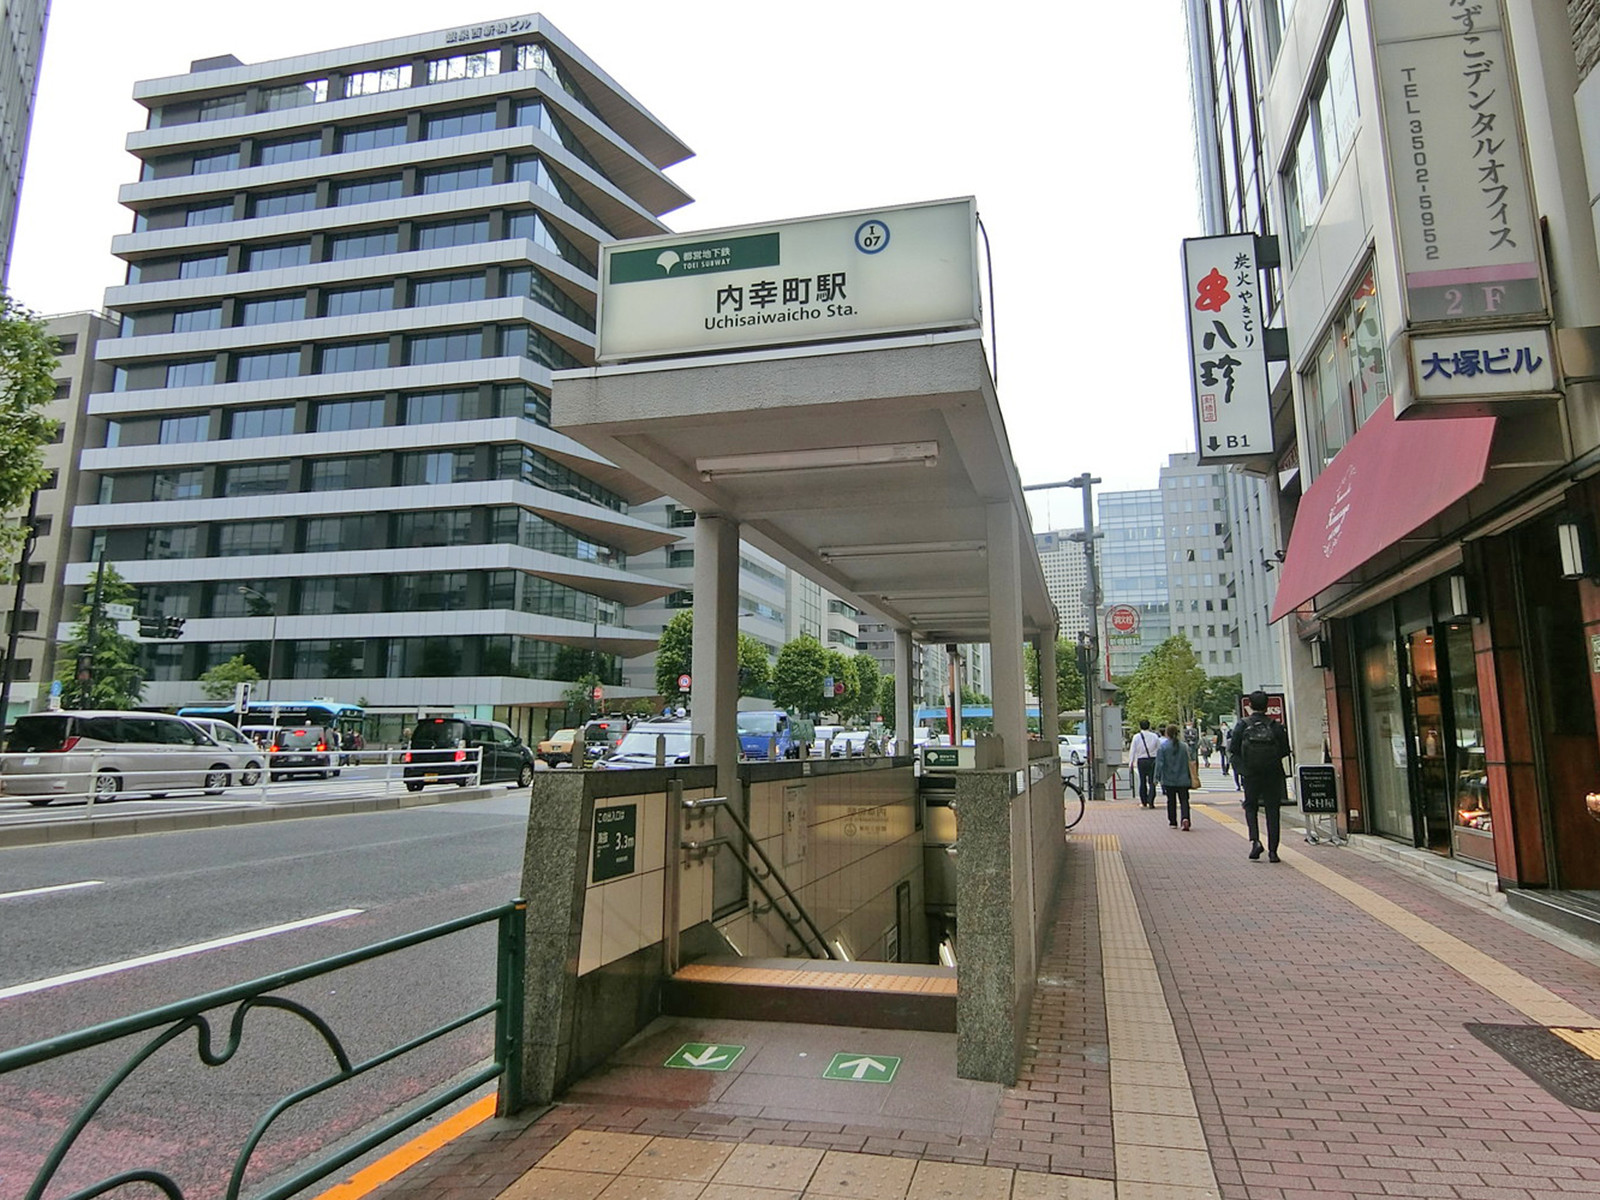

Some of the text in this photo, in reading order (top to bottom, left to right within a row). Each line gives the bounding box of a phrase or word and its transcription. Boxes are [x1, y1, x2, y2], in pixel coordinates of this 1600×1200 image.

[1401, 67, 1440, 260] TEL 3502-5952
[864, 235, 881, 247] 07
[683, 246, 731, 261] 都営地下鉄
[683, 258, 731, 270] TOEI SUBWAY
[716, 272, 847, 314] 内幸町駅
[1234, 252, 1255, 348] 炭火やきとり
[704, 304, 858, 330] Uchisaiwaicho Sta.
[1421, 347, 1543, 380] 大塚ビル
[1226, 434, 1251, 449] B1
[1305, 798, 1335, 808] 木村屋
